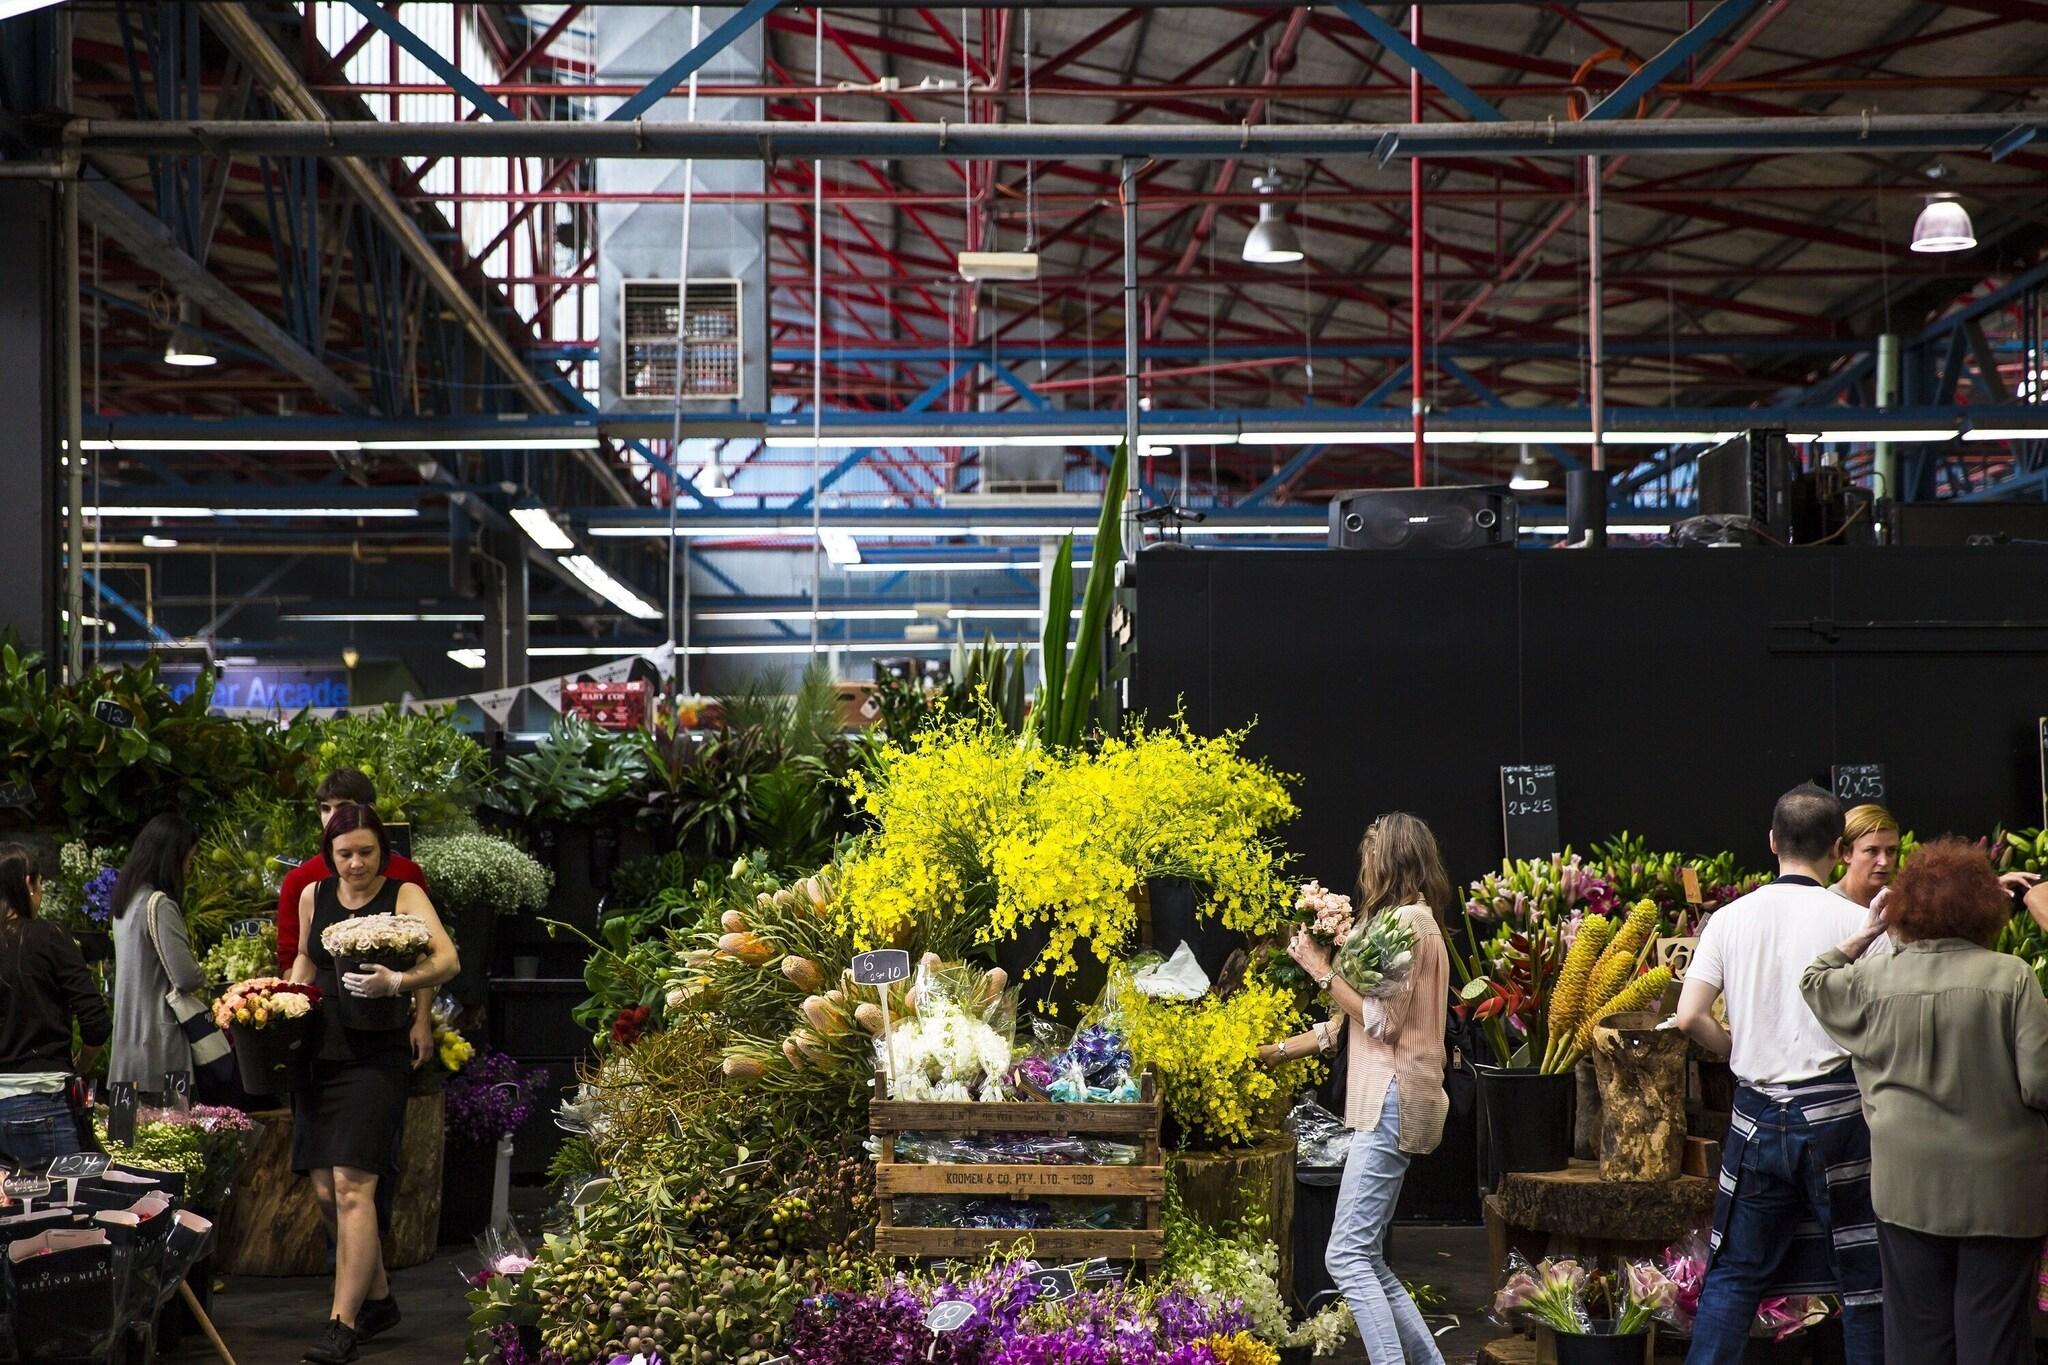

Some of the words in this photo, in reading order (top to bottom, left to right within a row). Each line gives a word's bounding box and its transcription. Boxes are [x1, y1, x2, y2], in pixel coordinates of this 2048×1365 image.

[246, 676, 348, 707] Arcade
[864, 954, 875, 971] 6
[888, 966, 901, 980] 10
[946, 1173, 983, 1184] KOOMEN
[986, 1173, 994, 1184] &
[997, 1173, 1012, 1184] CO.
[1015, 1173, 1036, 1185] PTY.
[1040, 1173, 1060, 1185] LTD.
[1040, 1276, 1060, 1298] 8
